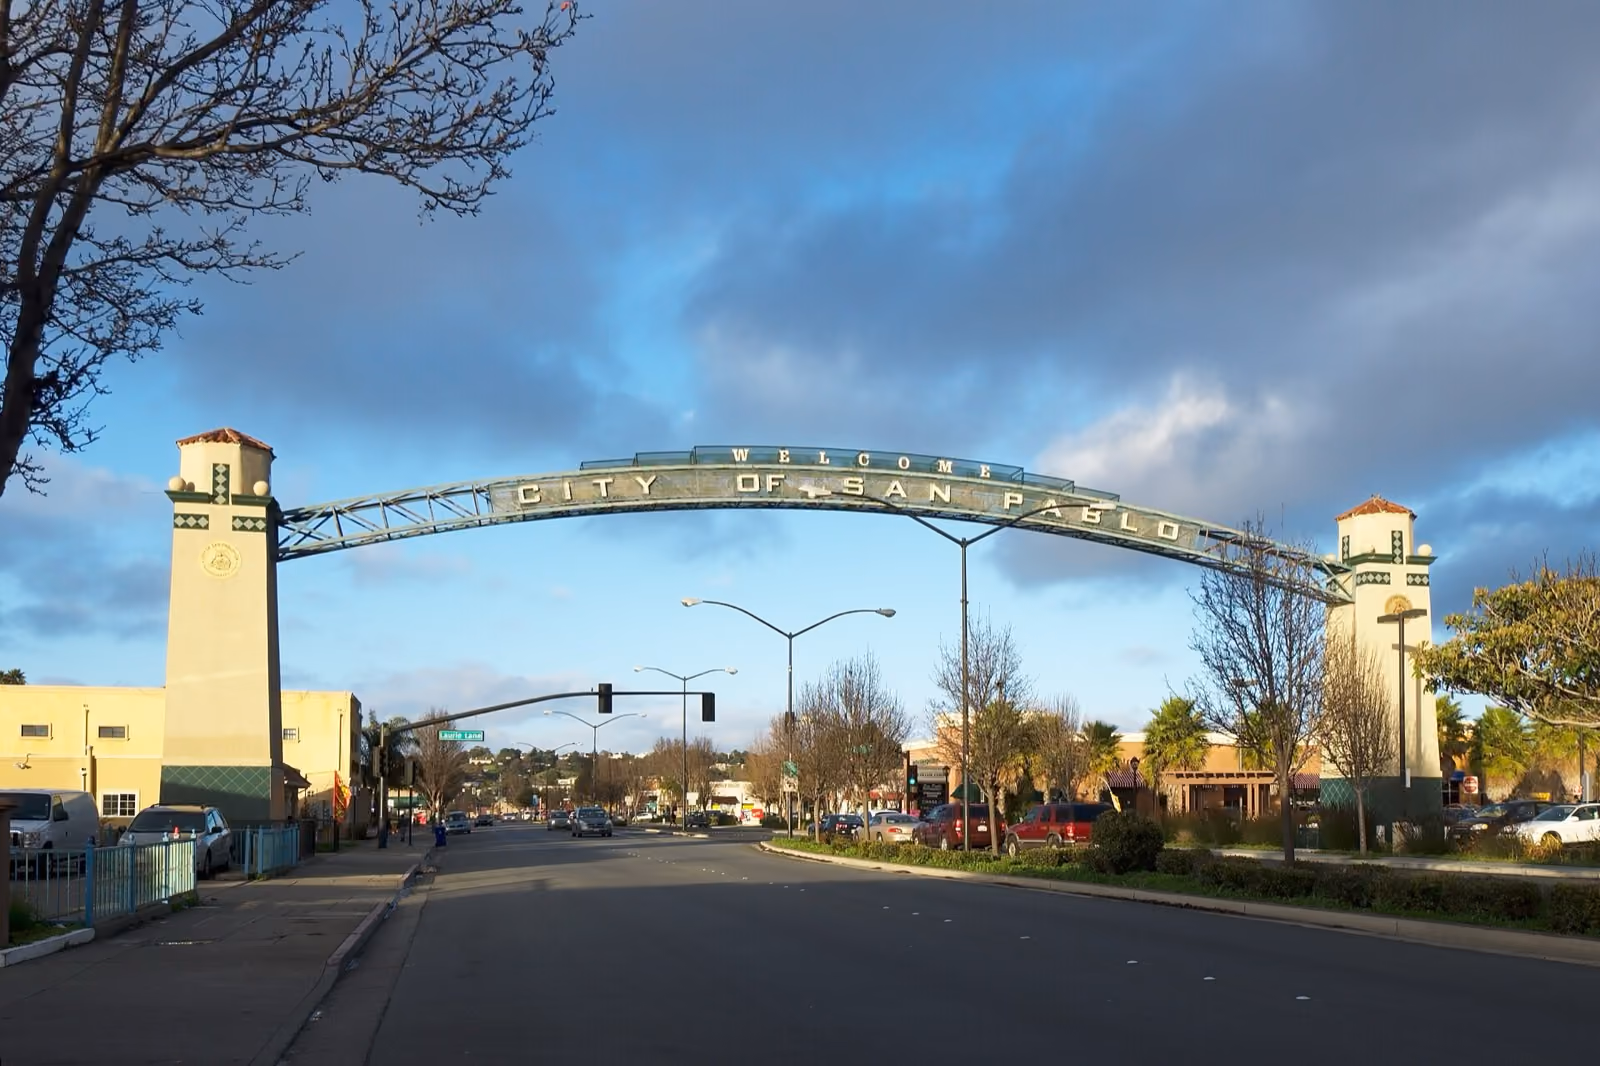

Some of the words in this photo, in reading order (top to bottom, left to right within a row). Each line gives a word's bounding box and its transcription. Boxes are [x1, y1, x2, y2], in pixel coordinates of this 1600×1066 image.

[731, 448, 991, 478] WELCOME
[517, 475, 657, 504] CITY
[736, 473, 786, 493] OF
[842, 476, 952, 504] SAN
[1003, 491, 1179, 540] PABLO
[440, 731, 462, 739] Laurie
[464, 731, 481, 739] Lane
